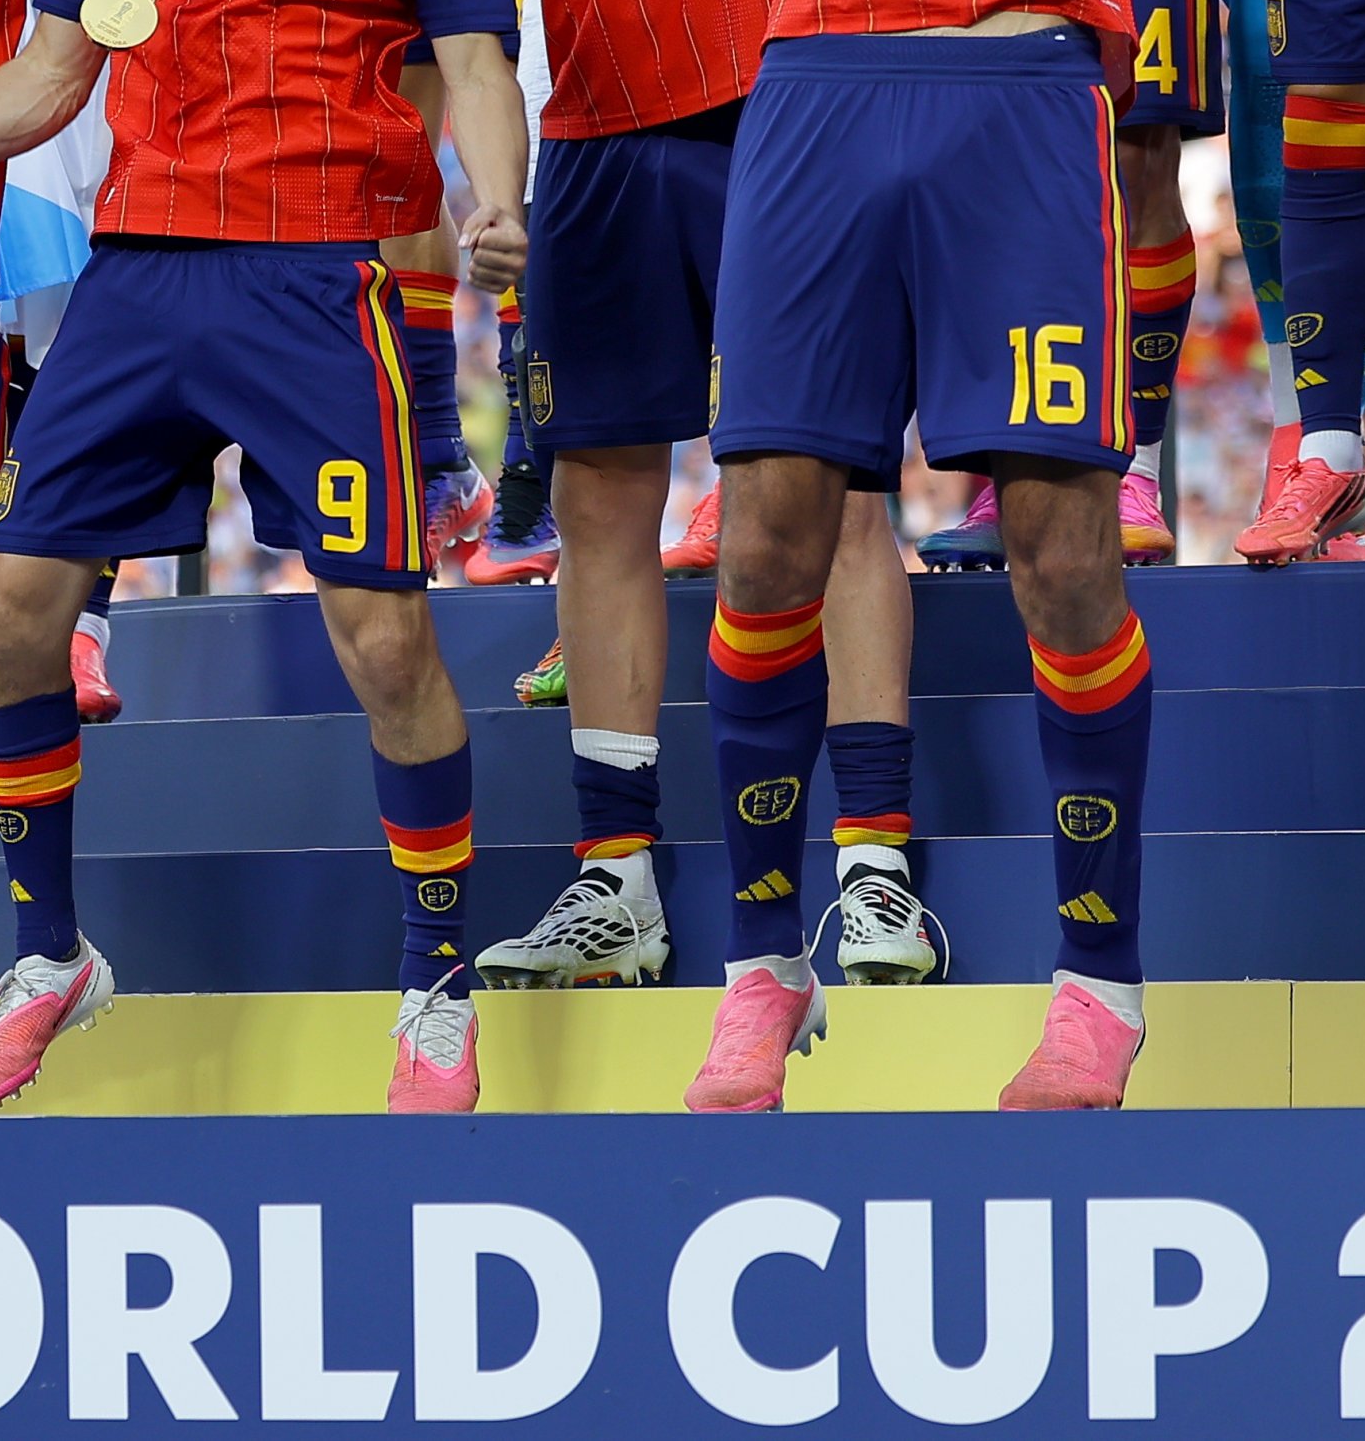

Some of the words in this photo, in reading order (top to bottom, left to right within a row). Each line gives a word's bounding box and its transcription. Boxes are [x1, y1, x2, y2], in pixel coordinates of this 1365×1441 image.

[1288, 318, 1311, 332] RF
[1290, 328, 1311, 341] EF
[1143, 338, 1170, 347] RF
[1143, 346, 1169, 356] EF
[1008, 325, 1086, 425] 16
[317, 459, 367, 554] 9
[1067, 804, 1100, 818] RF
[0, 816, 17, 825] RF
[1068, 818, 1101, 831] EF
[0, 825, 19, 836] EF
[426, 885, 449, 894] RF
[427, 894, 450, 904] EF
[668, 1197, 1269, 1426] CUP
